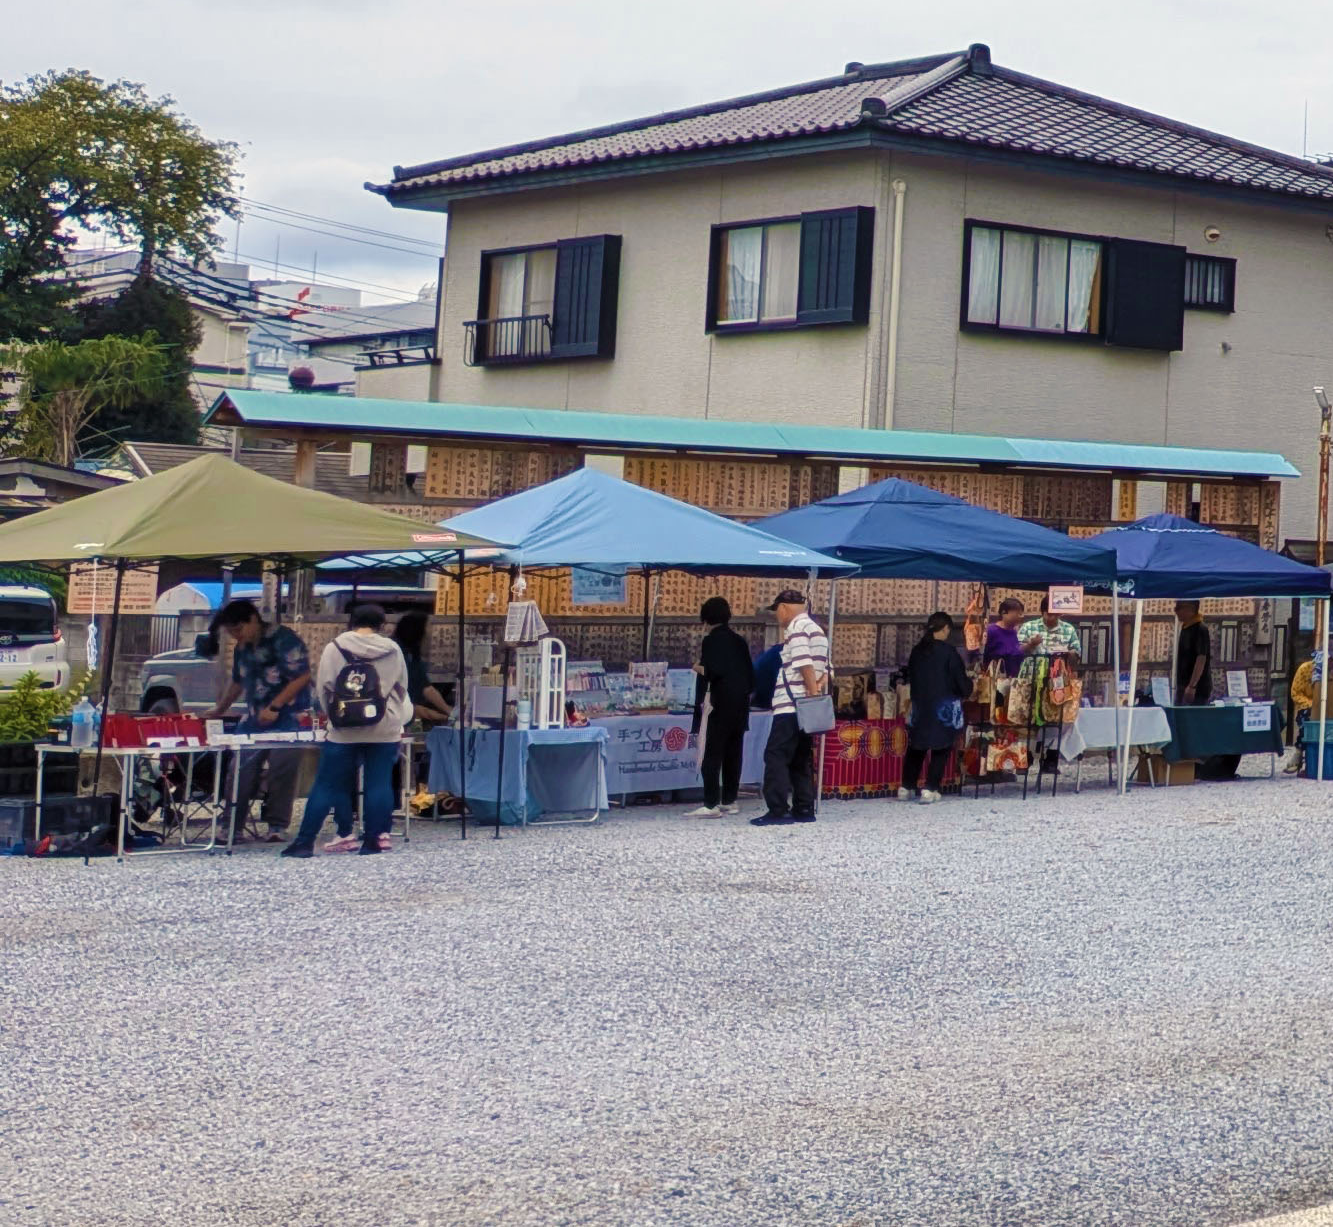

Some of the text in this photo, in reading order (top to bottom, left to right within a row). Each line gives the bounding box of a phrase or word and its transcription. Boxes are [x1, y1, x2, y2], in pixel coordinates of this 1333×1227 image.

[617, 727, 666, 742] 手づくり
[637, 739, 663, 753] 工房
